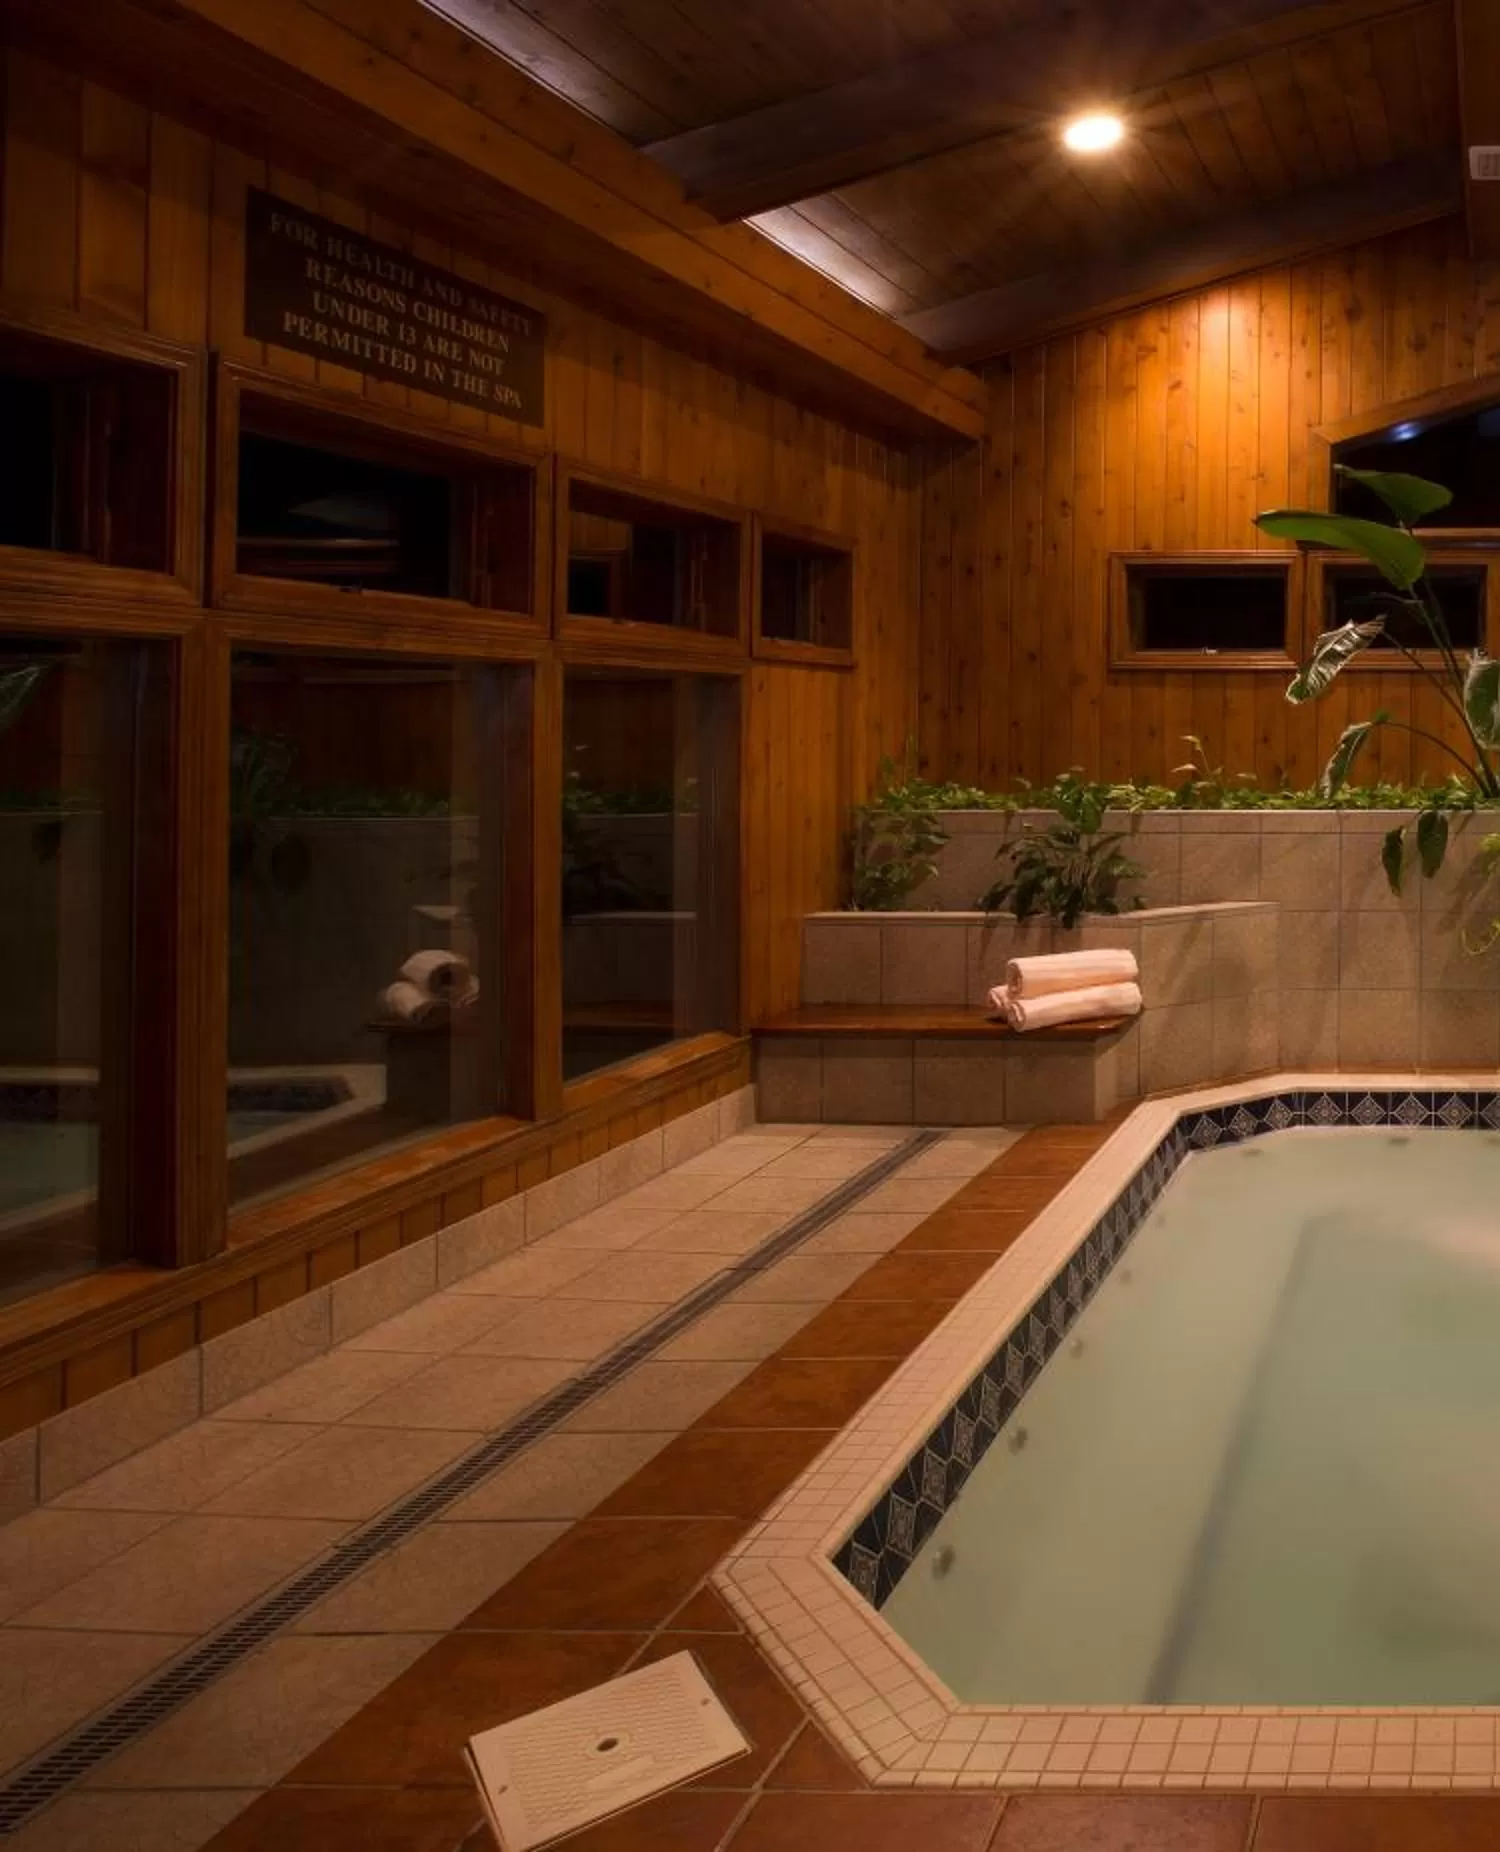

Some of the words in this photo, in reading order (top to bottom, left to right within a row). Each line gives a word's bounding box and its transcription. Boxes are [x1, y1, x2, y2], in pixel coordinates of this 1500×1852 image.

[270, 212, 318, 250] FOR
[327, 236, 414, 289] HEALTH
[422, 275, 462, 307] AND
[306, 258, 407, 314] REASONS
[413, 302, 510, 353] CHILDREN
[283, 311, 417, 373] PERMITTED
[423, 360, 446, 384] IN
[452, 371, 488, 396] THE
[494, 385, 522, 409] SPA
[312, 292, 390, 336] UNDER
[398, 323, 417, 345] 13
[423, 335, 464, 362] ARE
[468, 349, 505, 375] NOT
